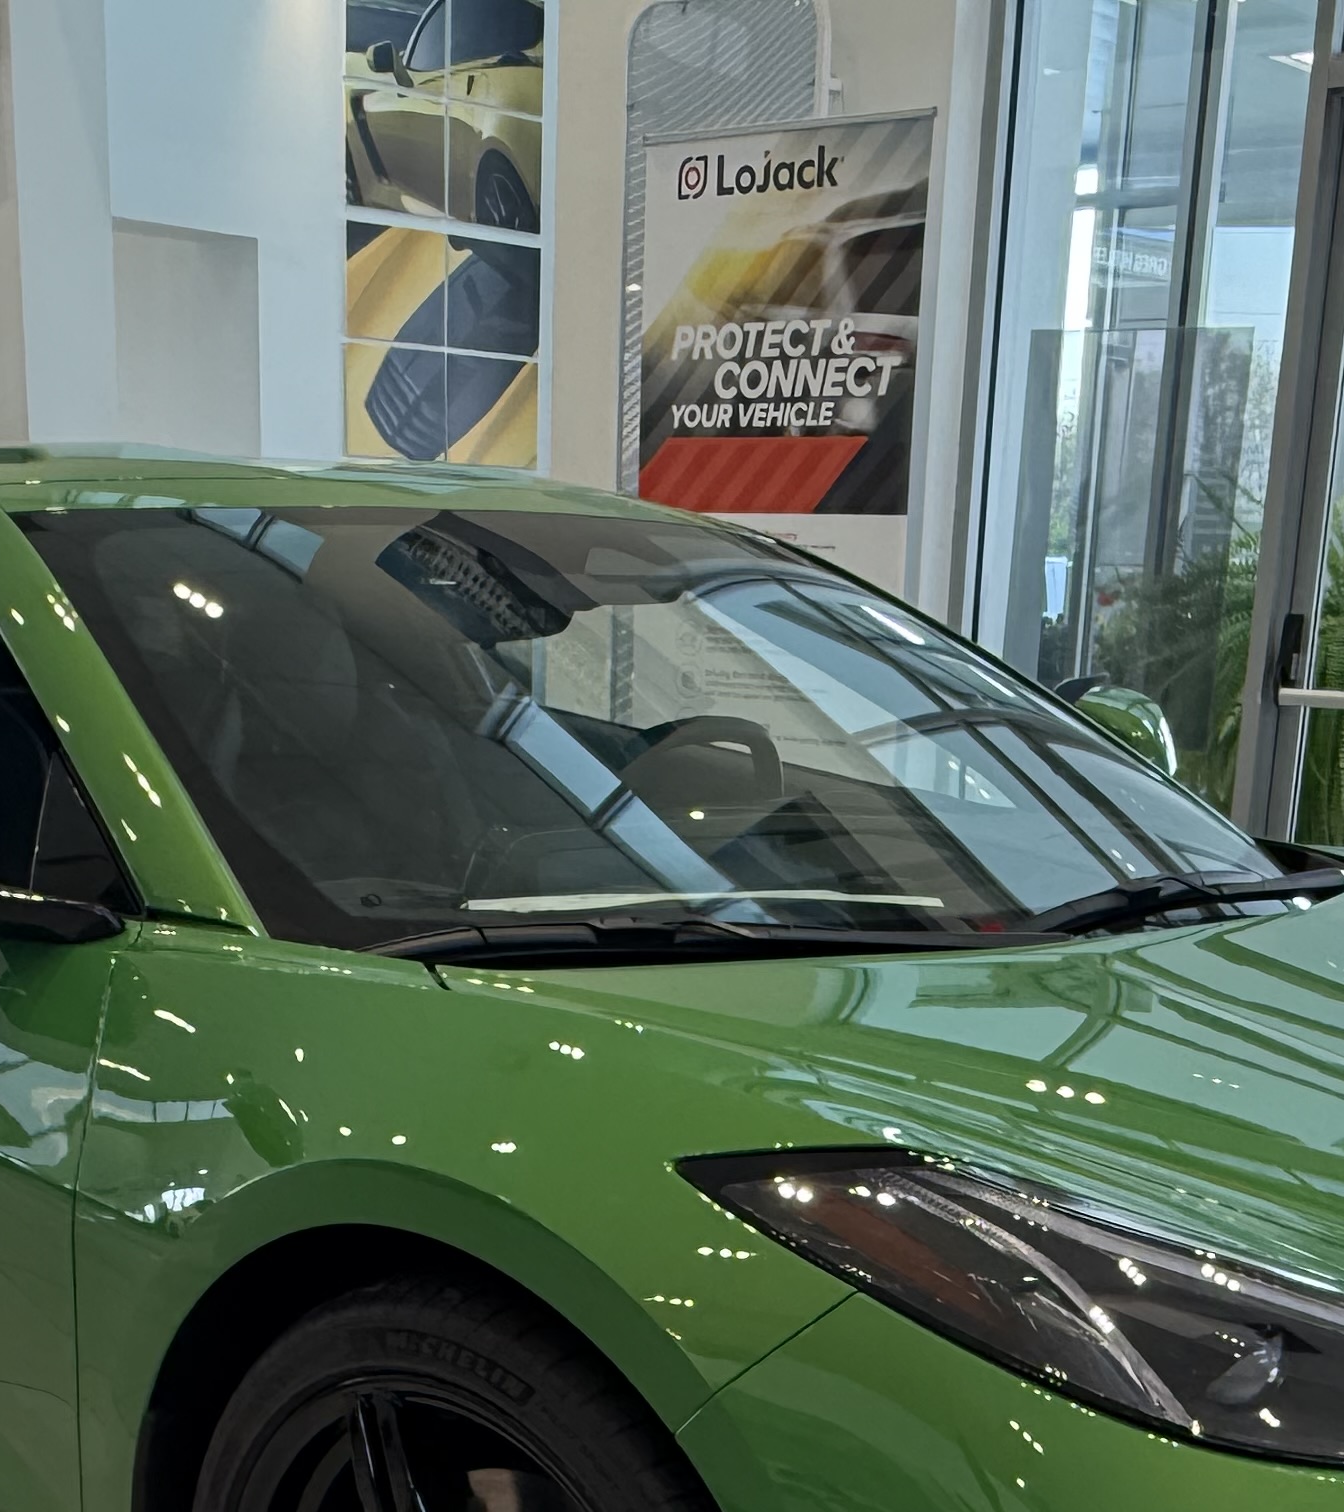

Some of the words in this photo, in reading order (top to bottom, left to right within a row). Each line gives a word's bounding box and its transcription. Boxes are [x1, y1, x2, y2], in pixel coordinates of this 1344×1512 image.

[714, 356, 902, 399] CONNECT
[671, 402, 732, 429] YOUR
[738, 401, 836, 428] VEHICLE
[387, 1332, 525, 1397] MICHELIN
